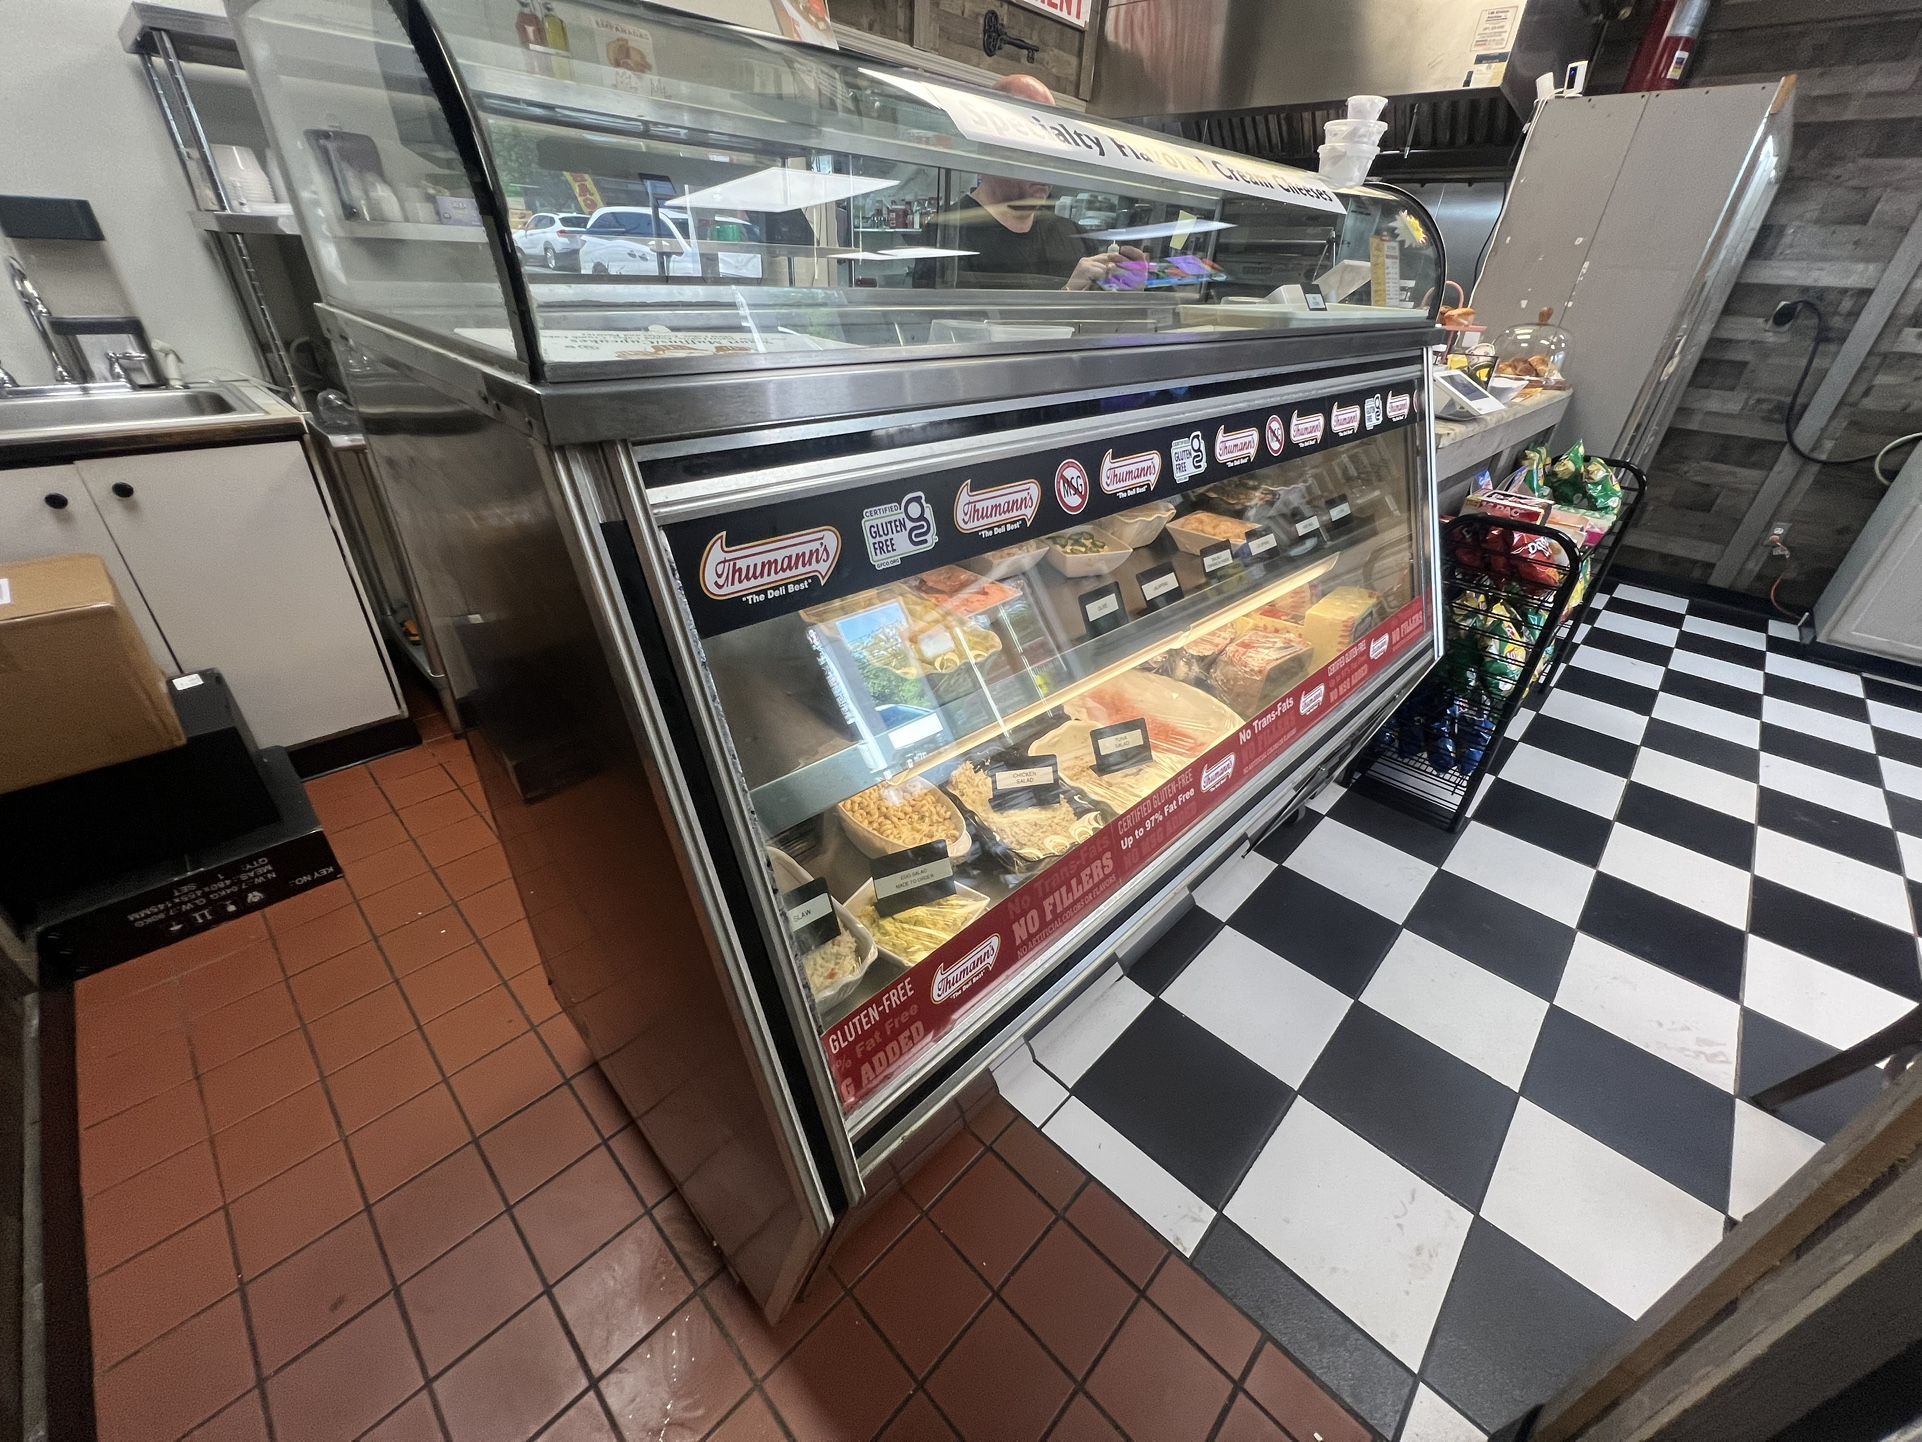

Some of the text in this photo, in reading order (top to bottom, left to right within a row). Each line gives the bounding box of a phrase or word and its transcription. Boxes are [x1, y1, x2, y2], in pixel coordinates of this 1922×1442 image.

[1212, 160, 1274, 189] Cream
[1272, 175, 1333, 202] Cheeses
[1174, 448, 1193, 462] GLUTEN
[1219, 434, 1255, 457] Thumann's
[1105, 457, 1156, 487] Thumann's
[1175, 462, 1187, 474] FREE
[1061, 475, 1083, 499] MSG
[864, 504, 899, 518] CERTIFIED
[962, 487, 1034, 525] Thumann's
[869, 517, 908, 540] GLUTEN
[979, 521, 1022, 538] "The Deli Best"
[872, 537, 897, 557] FREE
[714, 535, 830, 589] Thumann's
[742, 579, 812, 605] "The Deli Best"
[1239, 728, 1252, 745] No
[1252, 696, 1294, 734] Trans-Fats
[1012, 770, 1037, 779] CHICKEN
[1016, 777, 1034, 785] SALAD
[1117, 800, 1152, 834] CERTIFIED
[1152, 768, 1193, 808] GLUTEN-FREE
[1120, 788, 1195, 850] Up to 97% Fat Free
[313, 866, 335, 880] KEY
[172, 883, 198, 897] SET
[1011, 851, 1114, 946] NO FILLERS
[937, 941, 995, 997] Thumann's
[829, 977, 915, 1054] GLUTEN-FREE
[860, 1020, 925, 1087] ADDED
